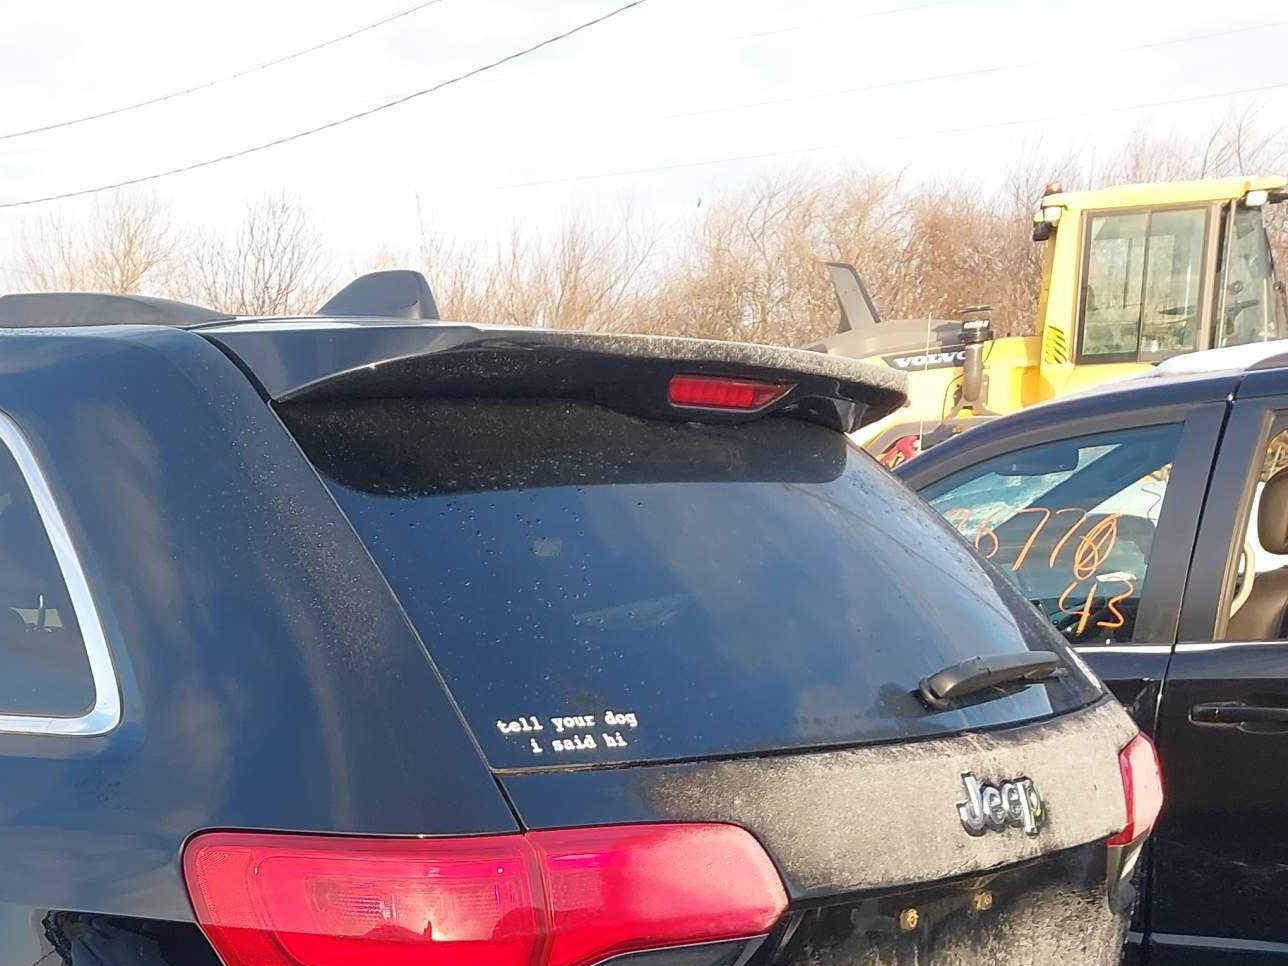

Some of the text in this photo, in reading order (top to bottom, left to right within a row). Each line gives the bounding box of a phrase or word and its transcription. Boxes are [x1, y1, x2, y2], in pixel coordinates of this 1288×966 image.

[496, 710, 639, 735] tell your dog
[529, 731, 629, 754] i said hi
[956, 770, 1046, 838] Jeep
